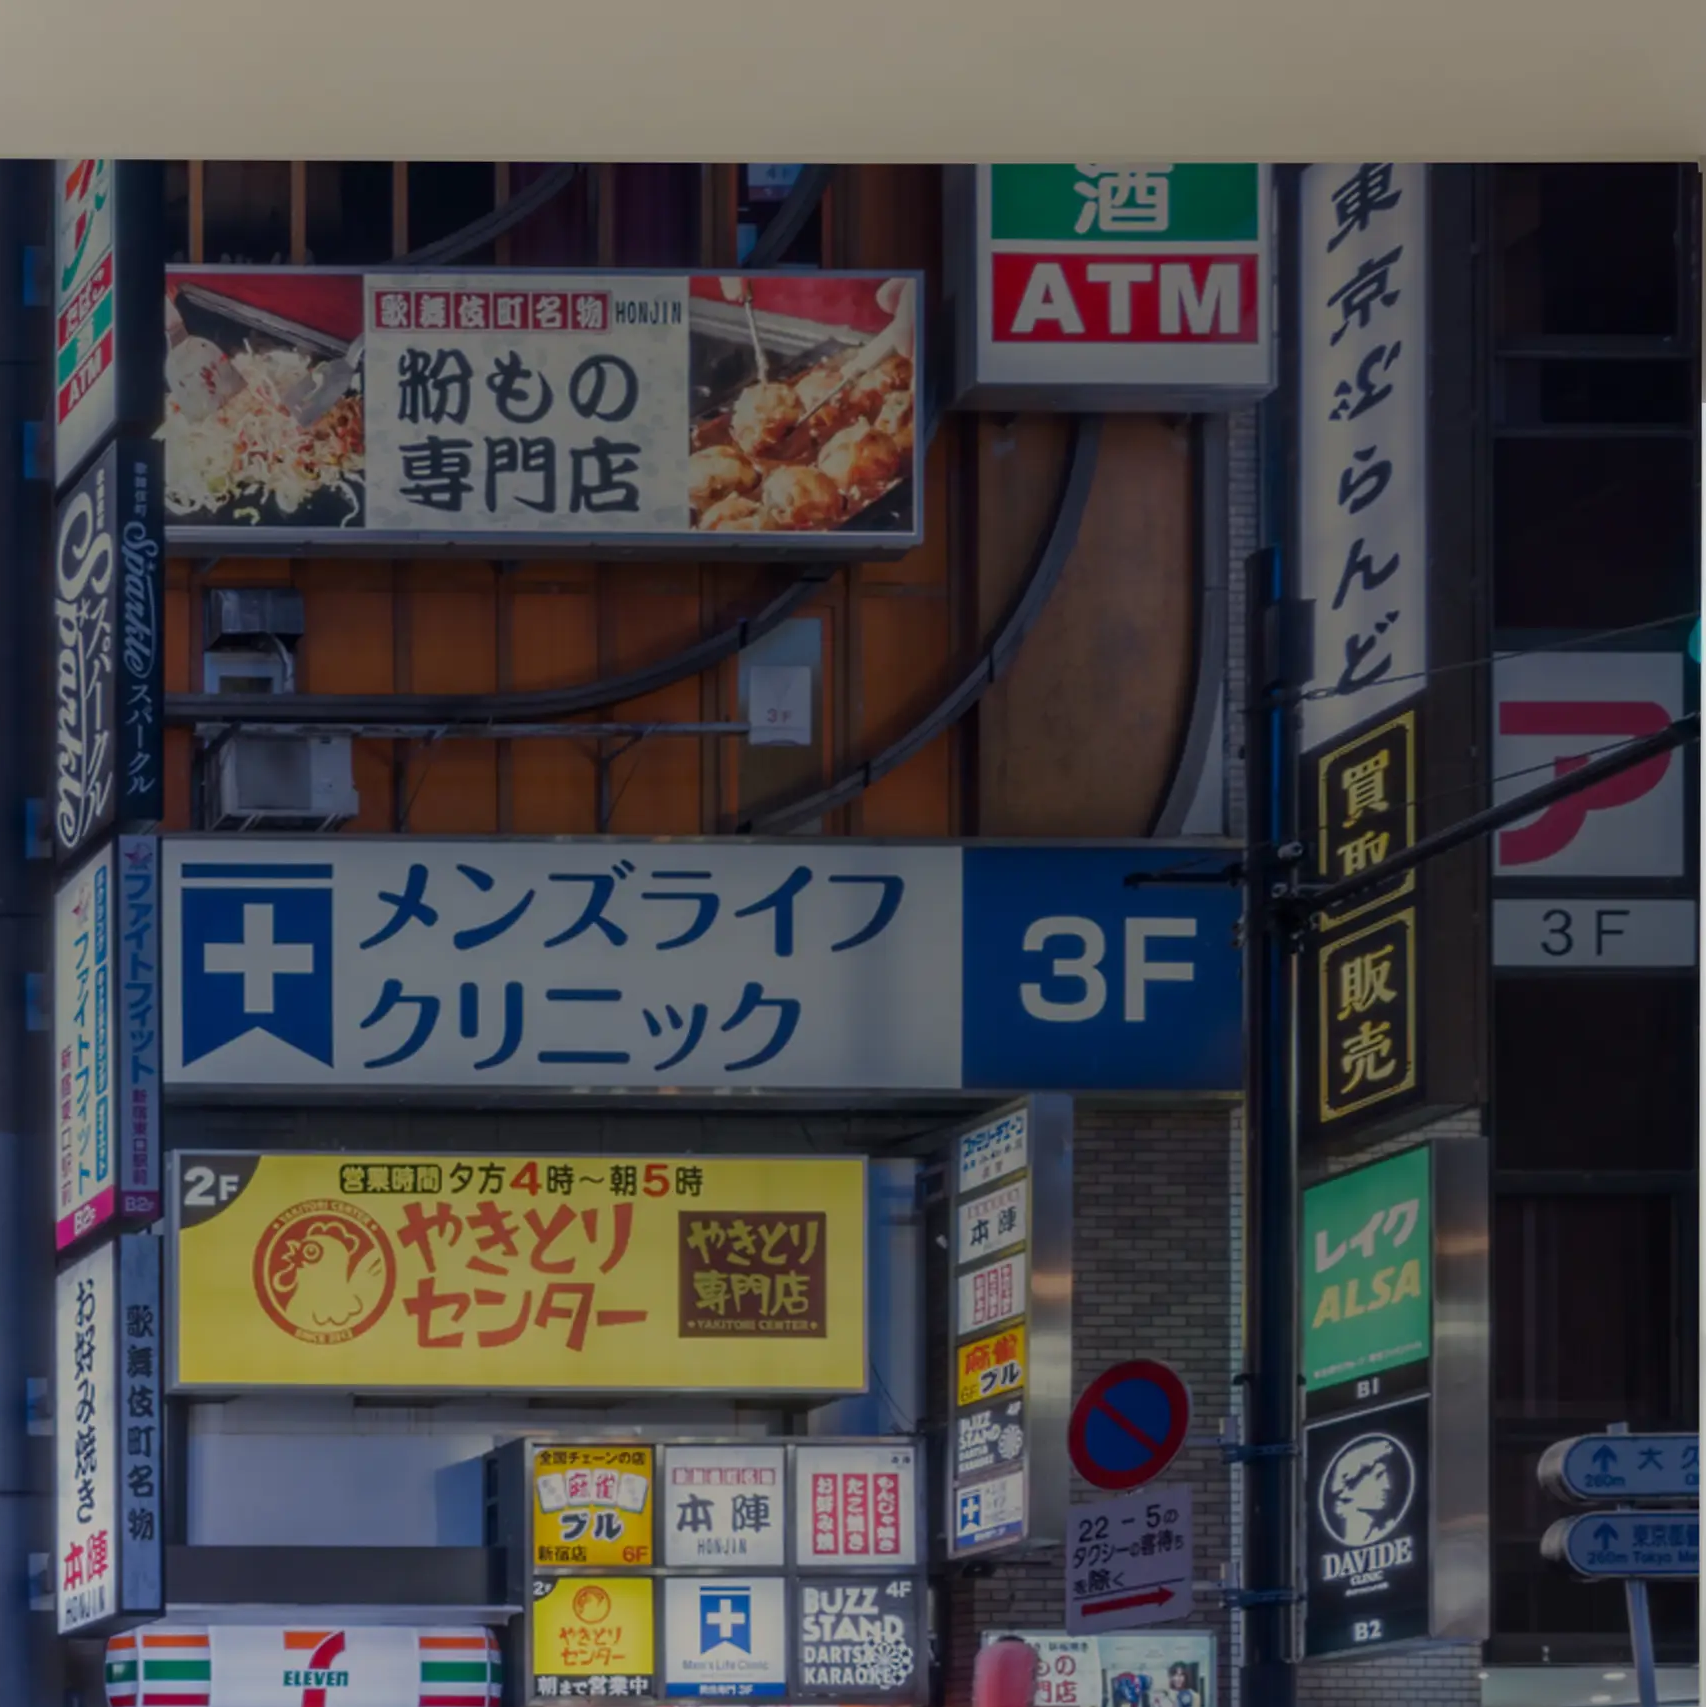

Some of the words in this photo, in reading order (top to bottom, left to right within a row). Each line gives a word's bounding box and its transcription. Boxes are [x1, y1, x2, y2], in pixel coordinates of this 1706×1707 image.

[1073, 163, 1173, 234] 酒
[379, 294, 605, 328] 歌舞伎町名物
[615, 300, 683, 326] HONJIN
[1009, 262, 1242, 337] ATM
[67, 346, 104, 411] ATM
[397, 348, 640, 426] 粉もの
[397, 435, 643, 514] 専門店
[765, 708, 792, 724] 3F
[125, 683, 157, 796] スパークル
[1338, 748, 1391, 886] 買取
[358, 859, 906, 960] メンズライフ
[1539, 907, 1632, 957] 3F
[123, 873, 155, 1084] ファイトフィット
[1018, 914, 1198, 1024] 3F
[359, 978, 802, 1073] クリニック
[1336, 942, 1399, 1096] 販売
[72, 930, 91, 1197] ファイトフィット
[183, 1166, 240, 1208] 2F
[342, 1165, 442, 1193] 営業時間
[396, 1200, 635, 1276] やきとり
[687, 1218, 819, 1266] やきとり
[969, 1206, 1018, 1246] 本陣
[1314, 1198, 1421, 1274] レイク
[403, 1277, 649, 1353] センター
[693, 1271, 811, 1316] 専門店
[1311, 1258, 1422, 1330] ALSA
[980, 1359, 1021, 1394] ブル
[1356, 1377, 1380, 1399] B1
[74, 1278, 98, 1525] お好み焼き
[126, 1304, 157, 1543] 歌舞伎町名物
[538, 1451, 647, 1467] 全国チェーンの店
[567, 1473, 617, 1501] 麻雀
[560, 1512, 622, 1543] ブル
[675, 1493, 772, 1534] 本陣
[63, 1529, 109, 1592] 本陣
[538, 1545, 587, 1563] 新宿店
[622, 1547, 649, 1563] 6F
[696, 1537, 749, 1556] HONJIN
[1322, 1536, 1414, 1582] DAVIDE
[1633, 1551, 1673, 1566] Tokyo
[532, 1581, 553, 1597] 2F
[885, 1581, 912, 1598] 4F
[1349, 1570, 1385, 1587] CLINIC
[803, 1587, 879, 1616] BUZZ
[558, 1625, 623, 1644] やきとり
[802, 1615, 905, 1643] STAND
[1353, 1618, 1383, 1642] B2
[559, 1647, 626, 1667] センター
[536, 1675, 649, 1697] 朝まで営業中
